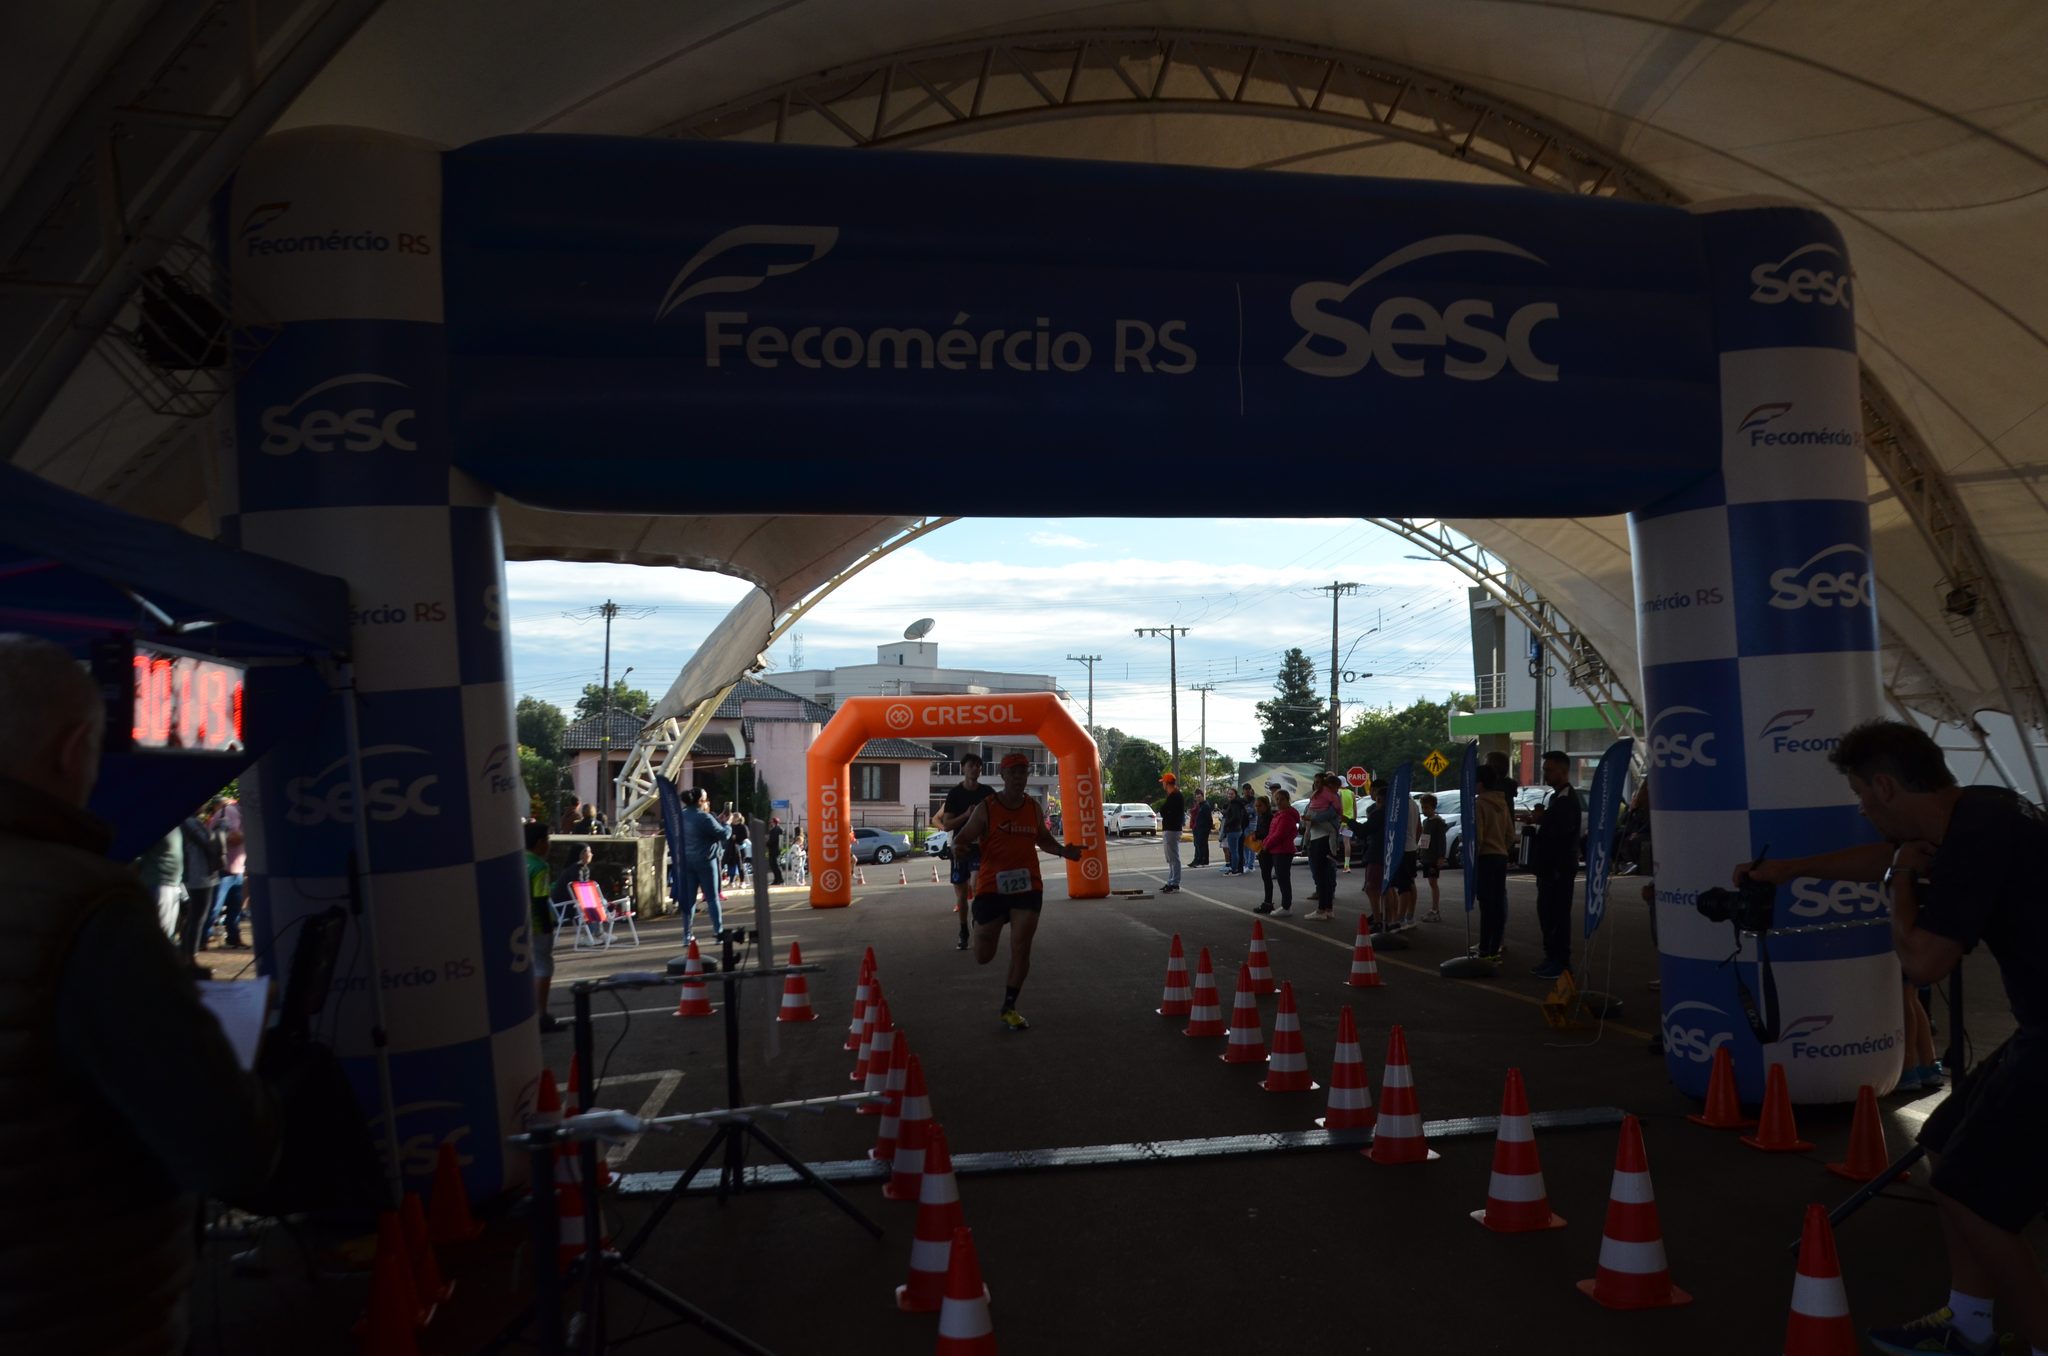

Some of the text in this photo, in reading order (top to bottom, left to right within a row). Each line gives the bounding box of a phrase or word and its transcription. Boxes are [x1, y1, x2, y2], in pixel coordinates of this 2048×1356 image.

[248, 229, 431, 257] Fecomércio RS
[705, 310, 1198, 375] Fecomércio RS
[1283, 280, 1560, 383] Sesc
[260, 404, 418, 457] Sesc
[1750, 426, 1852, 447] Fecomércio
[1695, 587, 1724, 607] RS
[414, 602, 447, 622] RS
[922, 703, 1023, 726] CRESOL
[1648, 731, 1718, 769] esc
[1774, 735, 1842, 754] Fecom
[1348, 773, 1367, 781] PARE
[820, 778, 840, 863] CRESOL
[1076, 767, 1098, 851] CRESOL
[1002, 877, 1027, 893] 123
[445, 958, 475, 981] RS
[1792, 1033, 1894, 1059] Fecomércio
